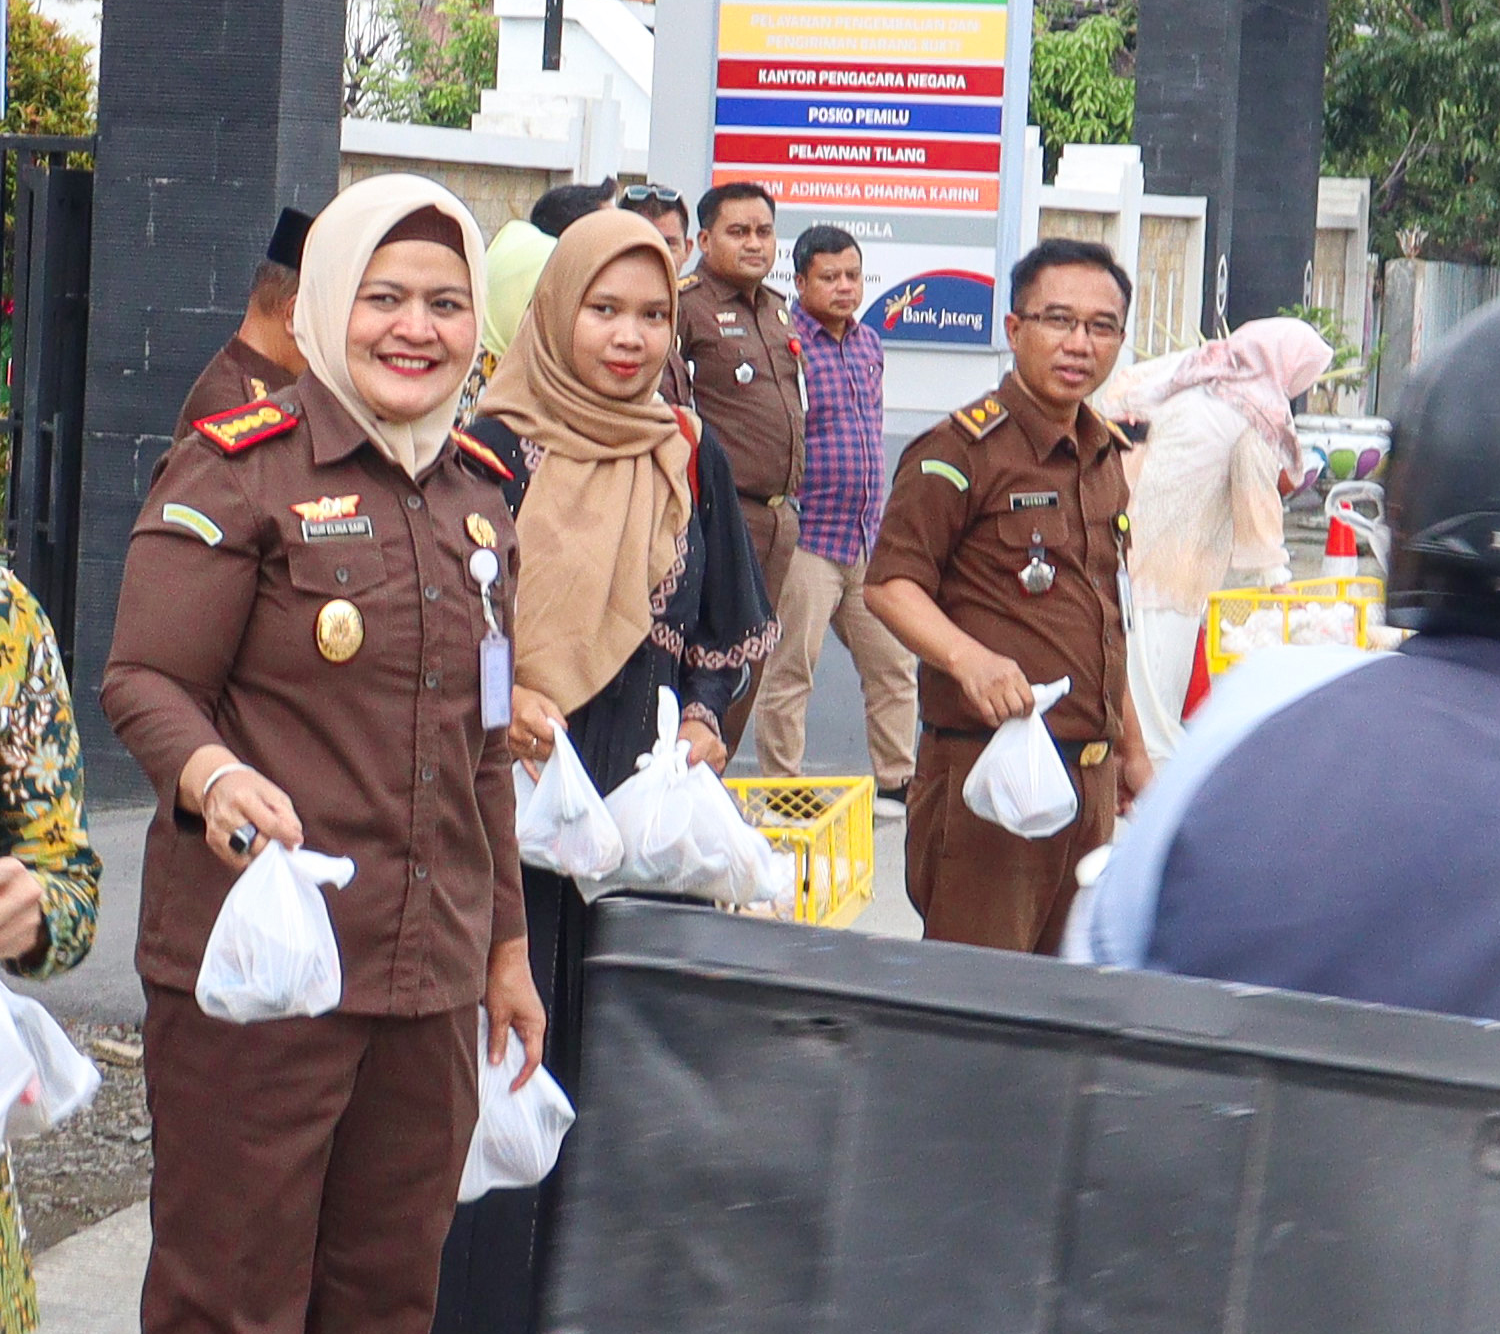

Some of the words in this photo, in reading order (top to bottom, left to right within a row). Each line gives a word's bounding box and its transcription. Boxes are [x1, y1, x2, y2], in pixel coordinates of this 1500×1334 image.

[758, 69, 816, 85] KANTOR
[819, 70, 904, 87] PENGACARA
[907, 73, 967, 89] NEGARA
[808, 106, 853, 123] POSKO
[855, 108, 910, 125] PEMILU
[789, 144, 871, 160] PELAYANAN
[874, 147, 926, 163] TILANG
[790, 183, 861, 199] ADHYAKSA
[865, 185, 926, 201] DHARMA
[929, 187, 979, 203] KARINI
[903, 307, 937, 325] Bank
[938, 308, 983, 331] Jateng
